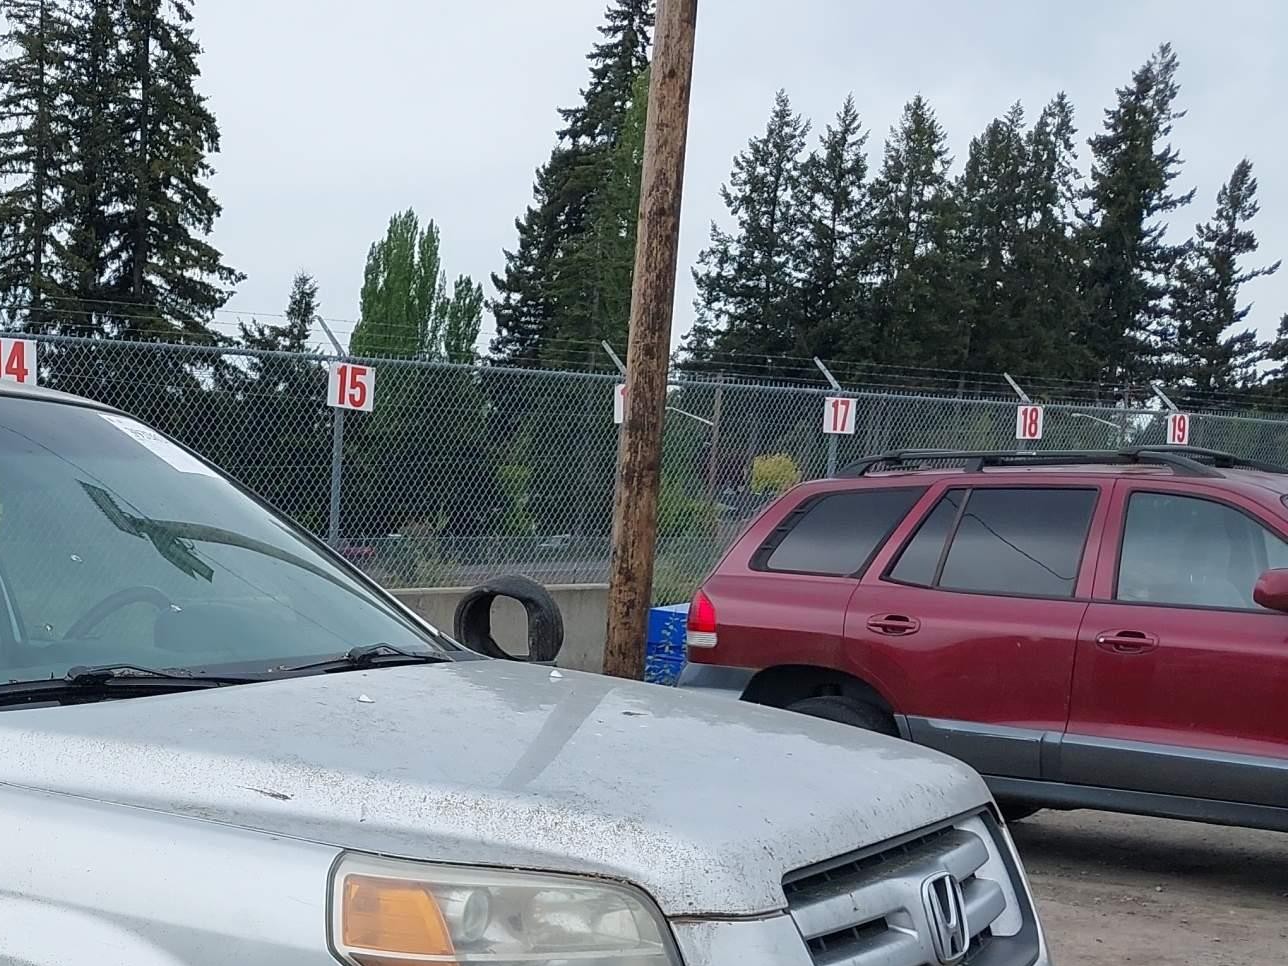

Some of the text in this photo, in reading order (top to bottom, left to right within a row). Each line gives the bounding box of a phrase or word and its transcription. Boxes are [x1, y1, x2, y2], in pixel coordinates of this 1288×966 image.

[337, 365, 367, 408] 15
[832, 399, 850, 431] 17
[1022, 407, 1039, 437] 18
[1172, 415, 1186, 443] 19
